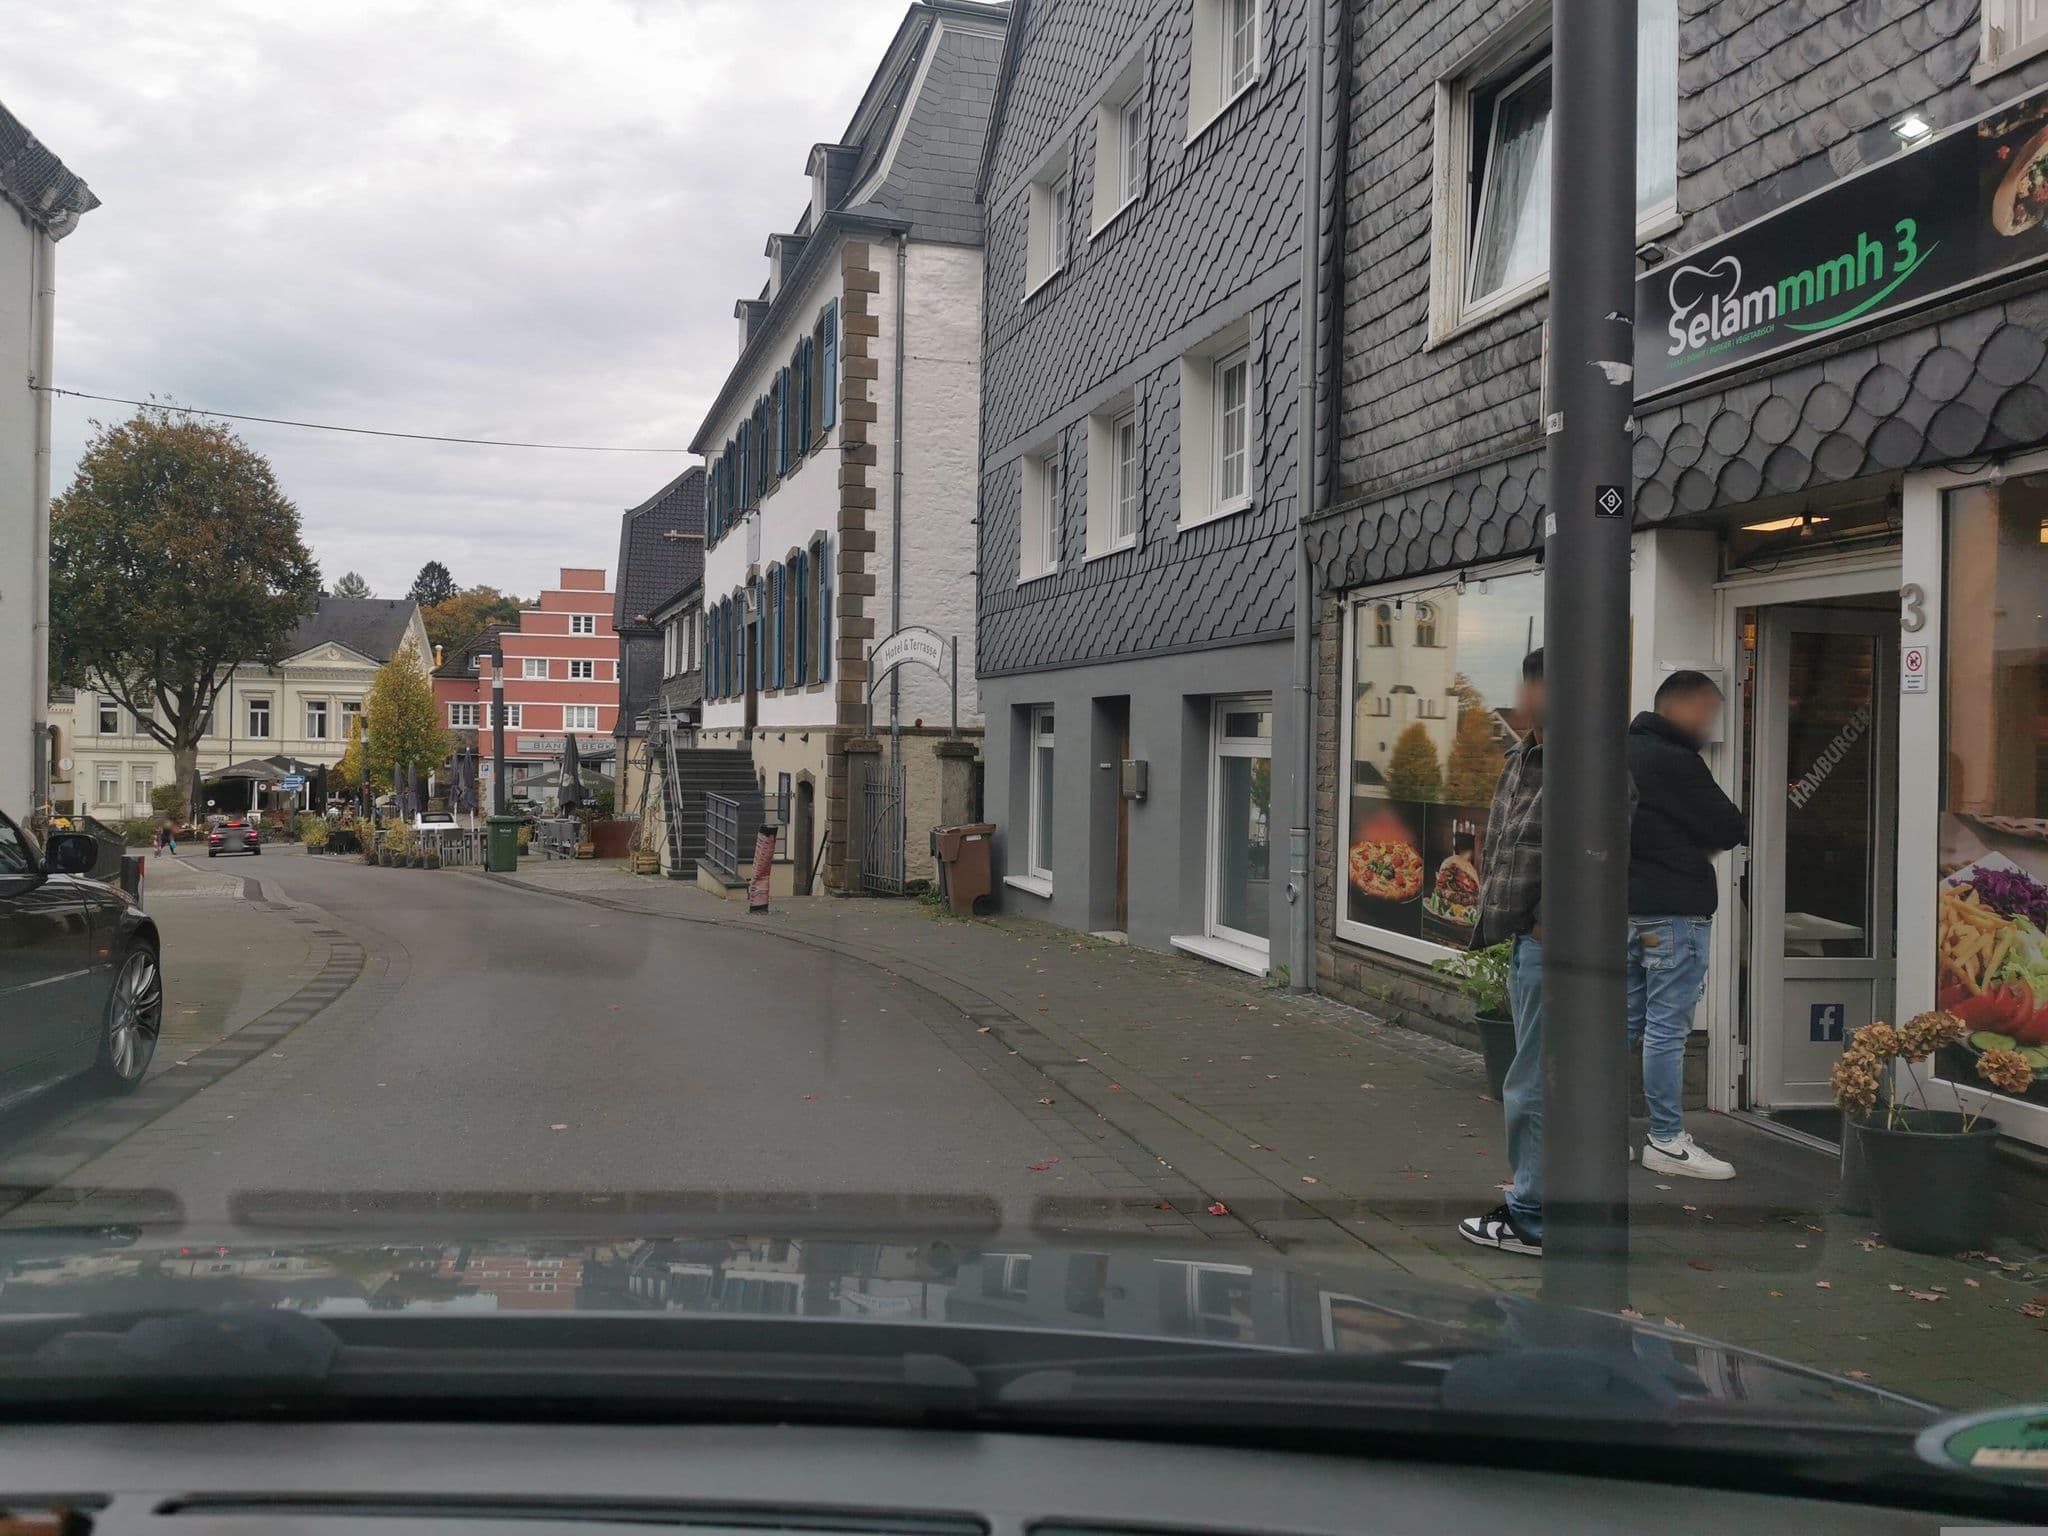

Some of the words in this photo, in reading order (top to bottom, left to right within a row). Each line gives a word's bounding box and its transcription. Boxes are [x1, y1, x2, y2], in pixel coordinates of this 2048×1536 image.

[1667, 231, 1884, 356] Selammmh
[1893, 218, 1917, 272] 3
[1607, 494, 1616, 507] 9
[1899, 583, 1926, 633] 3
[885, 640, 903, 661] Hotel
[903, 639, 909, 651] &
[910, 639, 937, 658] Terrasse
[1788, 708, 1870, 809] HAMBURGER
